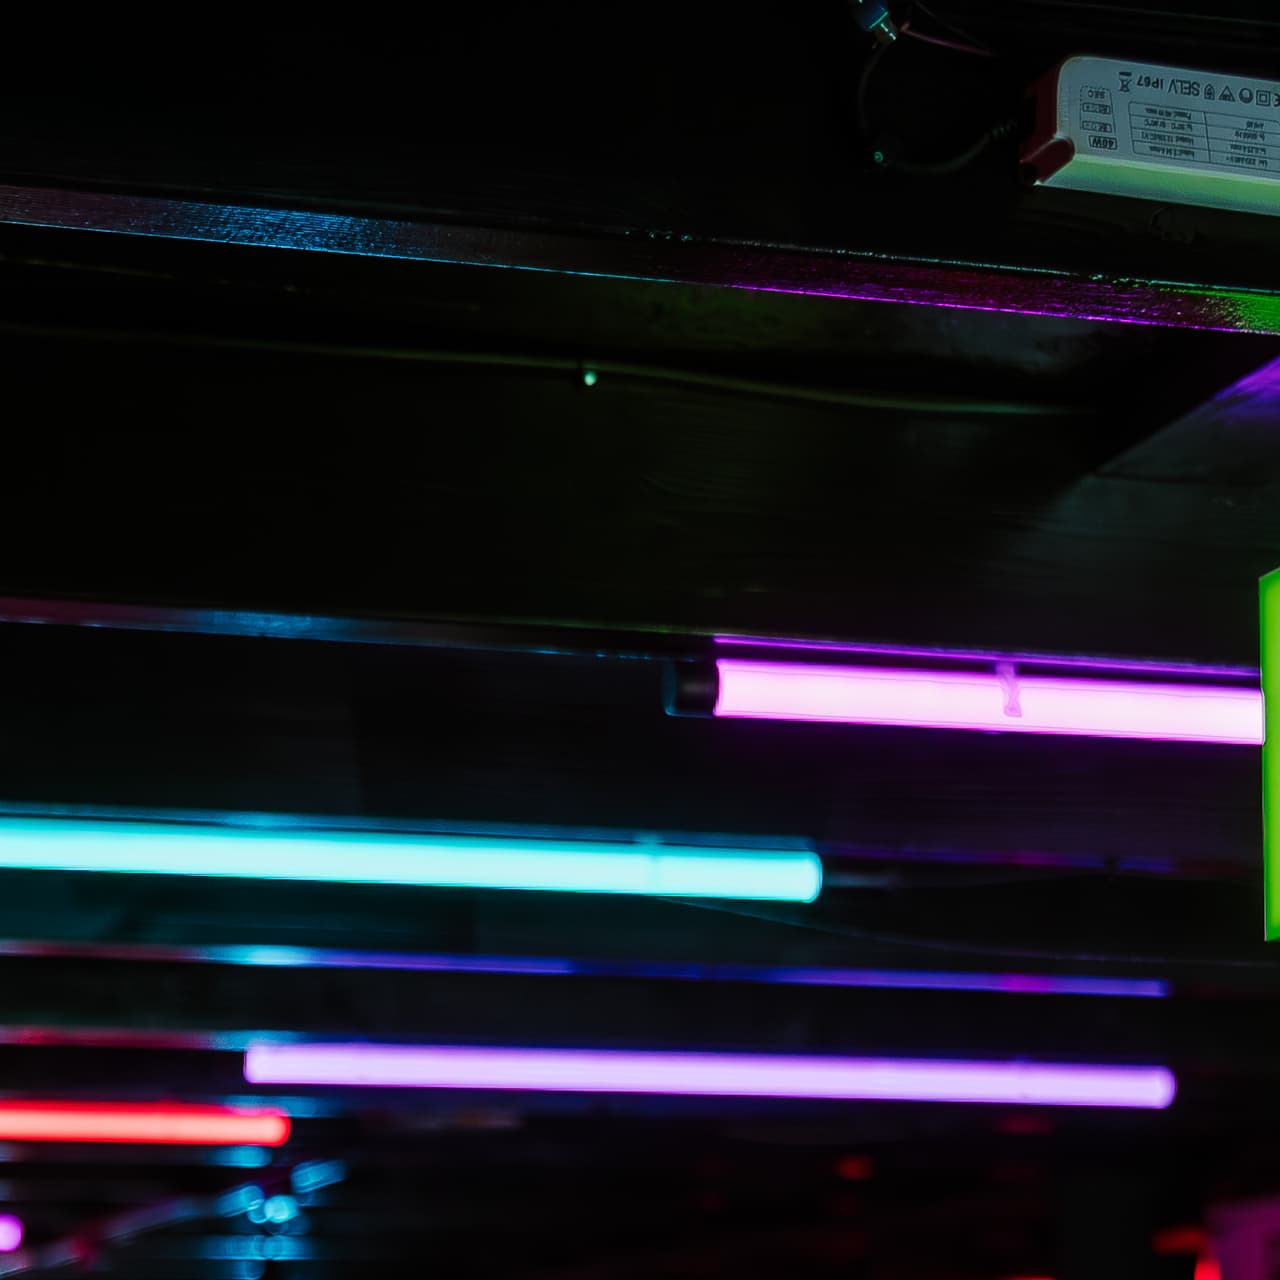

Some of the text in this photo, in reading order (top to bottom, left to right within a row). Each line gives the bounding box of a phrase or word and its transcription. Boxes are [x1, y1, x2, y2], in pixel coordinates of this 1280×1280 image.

[1136, 75, 1164, 90] IP67
[1167, 79, 1200, 97] SELV
[1092, 137, 1114, 149] 40W
